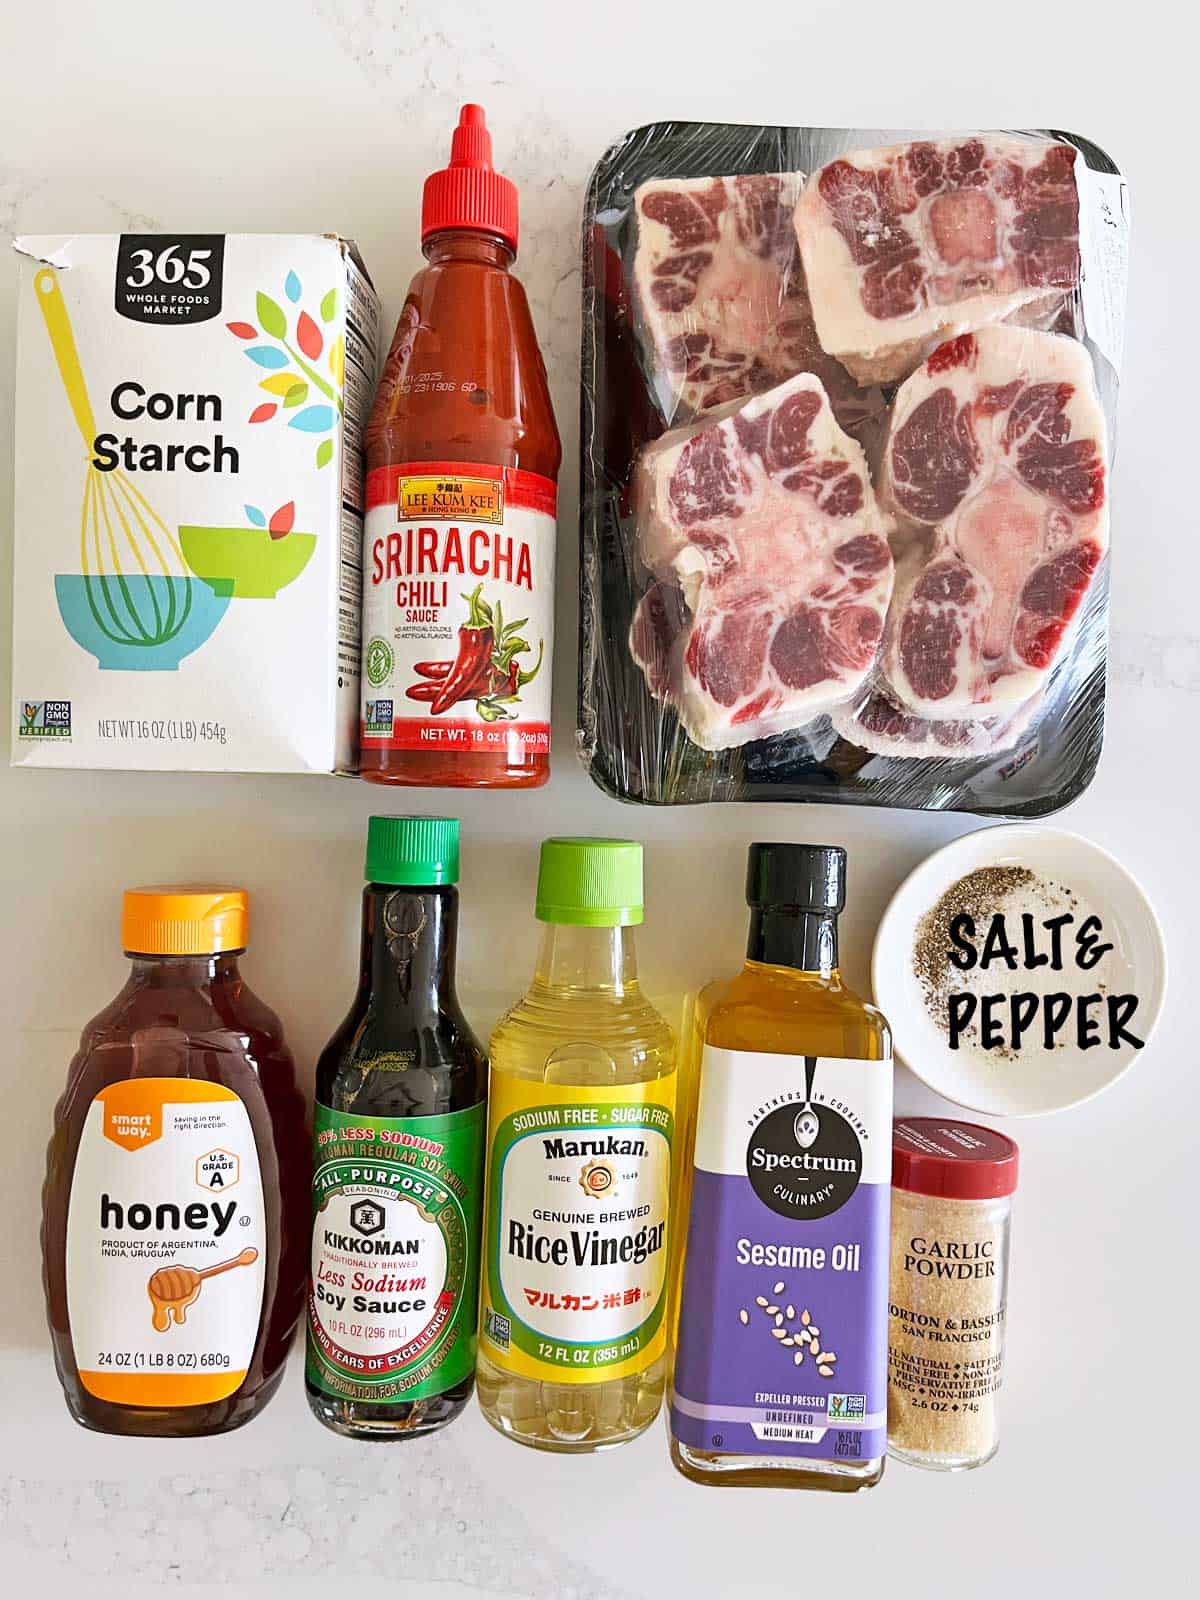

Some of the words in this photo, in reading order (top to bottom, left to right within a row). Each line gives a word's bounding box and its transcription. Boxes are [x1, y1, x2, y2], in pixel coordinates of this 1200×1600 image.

[126, 244, 213, 289] 365
[126, 294, 167, 305] WHOLE
[171, 294, 210, 305] FOODS
[143, 305, 192, 315] MARKET
[110, 381, 223, 421] Corn
[92, 434, 240, 474] Starch
[407, 493, 429, 506] LEE
[432, 494, 465, 507] KUM
[470, 495, 495, 509] KEE
[372, 527, 533, 591] SRIRACHA
[396, 581, 448, 608] CHILI
[405, 609, 439, 623] SAUCE
[46, 702, 69, 711] NON
[46, 711, 70, 720] GMO
[98, 720, 117, 738] NET
[118, 720, 136, 738] WT
[137, 720, 149, 739] 16
[151, 721, 165, 739] OZ
[180, 720, 197, 742] LB)
[200, 721, 227, 744] 454g
[420, 728, 444, 740] NET
[447, 729, 467, 741] WT.
[471, 729, 484, 742] 18
[487, 733, 499, 742] oz
[747, 1091, 801, 1126] PARTNERS
[814, 1092, 825, 1101] IN
[112, 1114, 152, 1125] smart
[174, 1116, 198, 1124] saving
[174, 1123, 192, 1131] right
[512, 1110, 561, 1132] SODIUM
[563, 1108, 599, 1124] FREE
[610, 1107, 649, 1123] SUGAR
[650, 1109, 670, 1128] FREE
[117, 1126, 152, 1138] way.
[339, 1126, 375, 1141] LESS
[381, 1129, 445, 1157] SODIUM
[543, 1135, 646, 1160] Marukan
[202, 1162, 234, 1171] GRADE
[209, 1154, 227, 1162] U.S.
[359, 1144, 417, 1165] REGULAR
[421, 1157, 445, 1175] SOY
[751, 1147, 857, 1173] Spectrum
[209, 1172, 224, 1187] A
[548, 1174, 572, 1183] SINCE
[344, 1186, 398, 1198] SEASONING
[100, 1194, 237, 1237] honey
[532, 1208, 595, 1224] GENUINE
[599, 1205, 650, 1223] BREWED
[101, 1239, 144, 1249] PRODUCT
[146, 1240, 159, 1249] OF
[161, 1239, 219, 1250] ARGENTINA,
[324, 1230, 420, 1255] KIKKOMAN
[508, 1219, 568, 1266] Rice
[570, 1220, 665, 1267] Vinegar
[910, 1237, 993, 1260] GARLIC
[101, 1249, 129, 1258] INDIA,
[130, 1249, 176, 1258] URUGUAY
[323, 1250, 379, 1269] TRADITIONALLY
[381, 1260, 418, 1269] BREWED
[736, 1238, 825, 1270] Sesame
[831, 1245, 860, 1272] Oil
[317, 1260, 346, 1288] Less
[351, 1271, 427, 1293] Sodium
[903, 1254, 996, 1280] POWDER
[316, 1284, 346, 1311] Soy
[353, 1295, 426, 1314] Sauce
[328, 1319, 337, 1331] 10
[338, 1321, 348, 1334] FL
[350, 1325, 362, 1337] OZ
[365, 1326, 385, 1339] (296
[388, 1326, 407, 1338] mL)
[901, 1324, 925, 1339] SAN
[928, 1330, 991, 1343] FRANCISCO
[944, 1318, 957, 1330] &
[317, 1328, 331, 1350] 300
[331, 1345, 365, 1369] YEARS
[368, 1358, 384, 1370] OF
[387, 1306, 449, 1366] EXCELLENCE
[98, 1353, 112, 1365] 24
[115, 1353, 131, 1365] OZ
[134, 1352, 145, 1368] (1
[149, 1353, 164, 1366] LB
[166, 1353, 174, 1366] 8
[177, 1352, 198, 1368] OZ)
[200, 1353, 230, 1367] 680g
[538, 1343, 552, 1358] 12
[555, 1347, 570, 1362] FL
[573, 1350, 589, 1363] OZ
[593, 1346, 618, 1366] (355
[621, 1336, 640, 1356] mL)
[889, 1346, 900, 1358] LL
[901, 1352, 952, 1370] NATURAL
[963, 1359, 985, 1371] SALT
[889, 1357, 920, 1375] LUTEN
[923, 1368, 950, 1380] FREE
[322, 1370, 377, 1400] INFORMATION
[379, 1383, 398, 1398] FOR
[399, 1364, 433, 1392] SODIUM
[893, 1378, 916, 1394] MSG
[895, 1370, 971, 1390] PRESERVATIVE
[755, 1392, 791, 1405] EXPELLER
[792, 1394, 826, 1408] PRESSED
[911, 1398, 928, 1410] 2.6
[930, 1401, 948, 1412] OZ
[962, 1402, 979, 1414] 74g
[765, 1411, 814, 1425] UNREFINED
[763, 1428, 794, 1439] MEDIUM
[795, 1430, 814, 1440] HEAT
